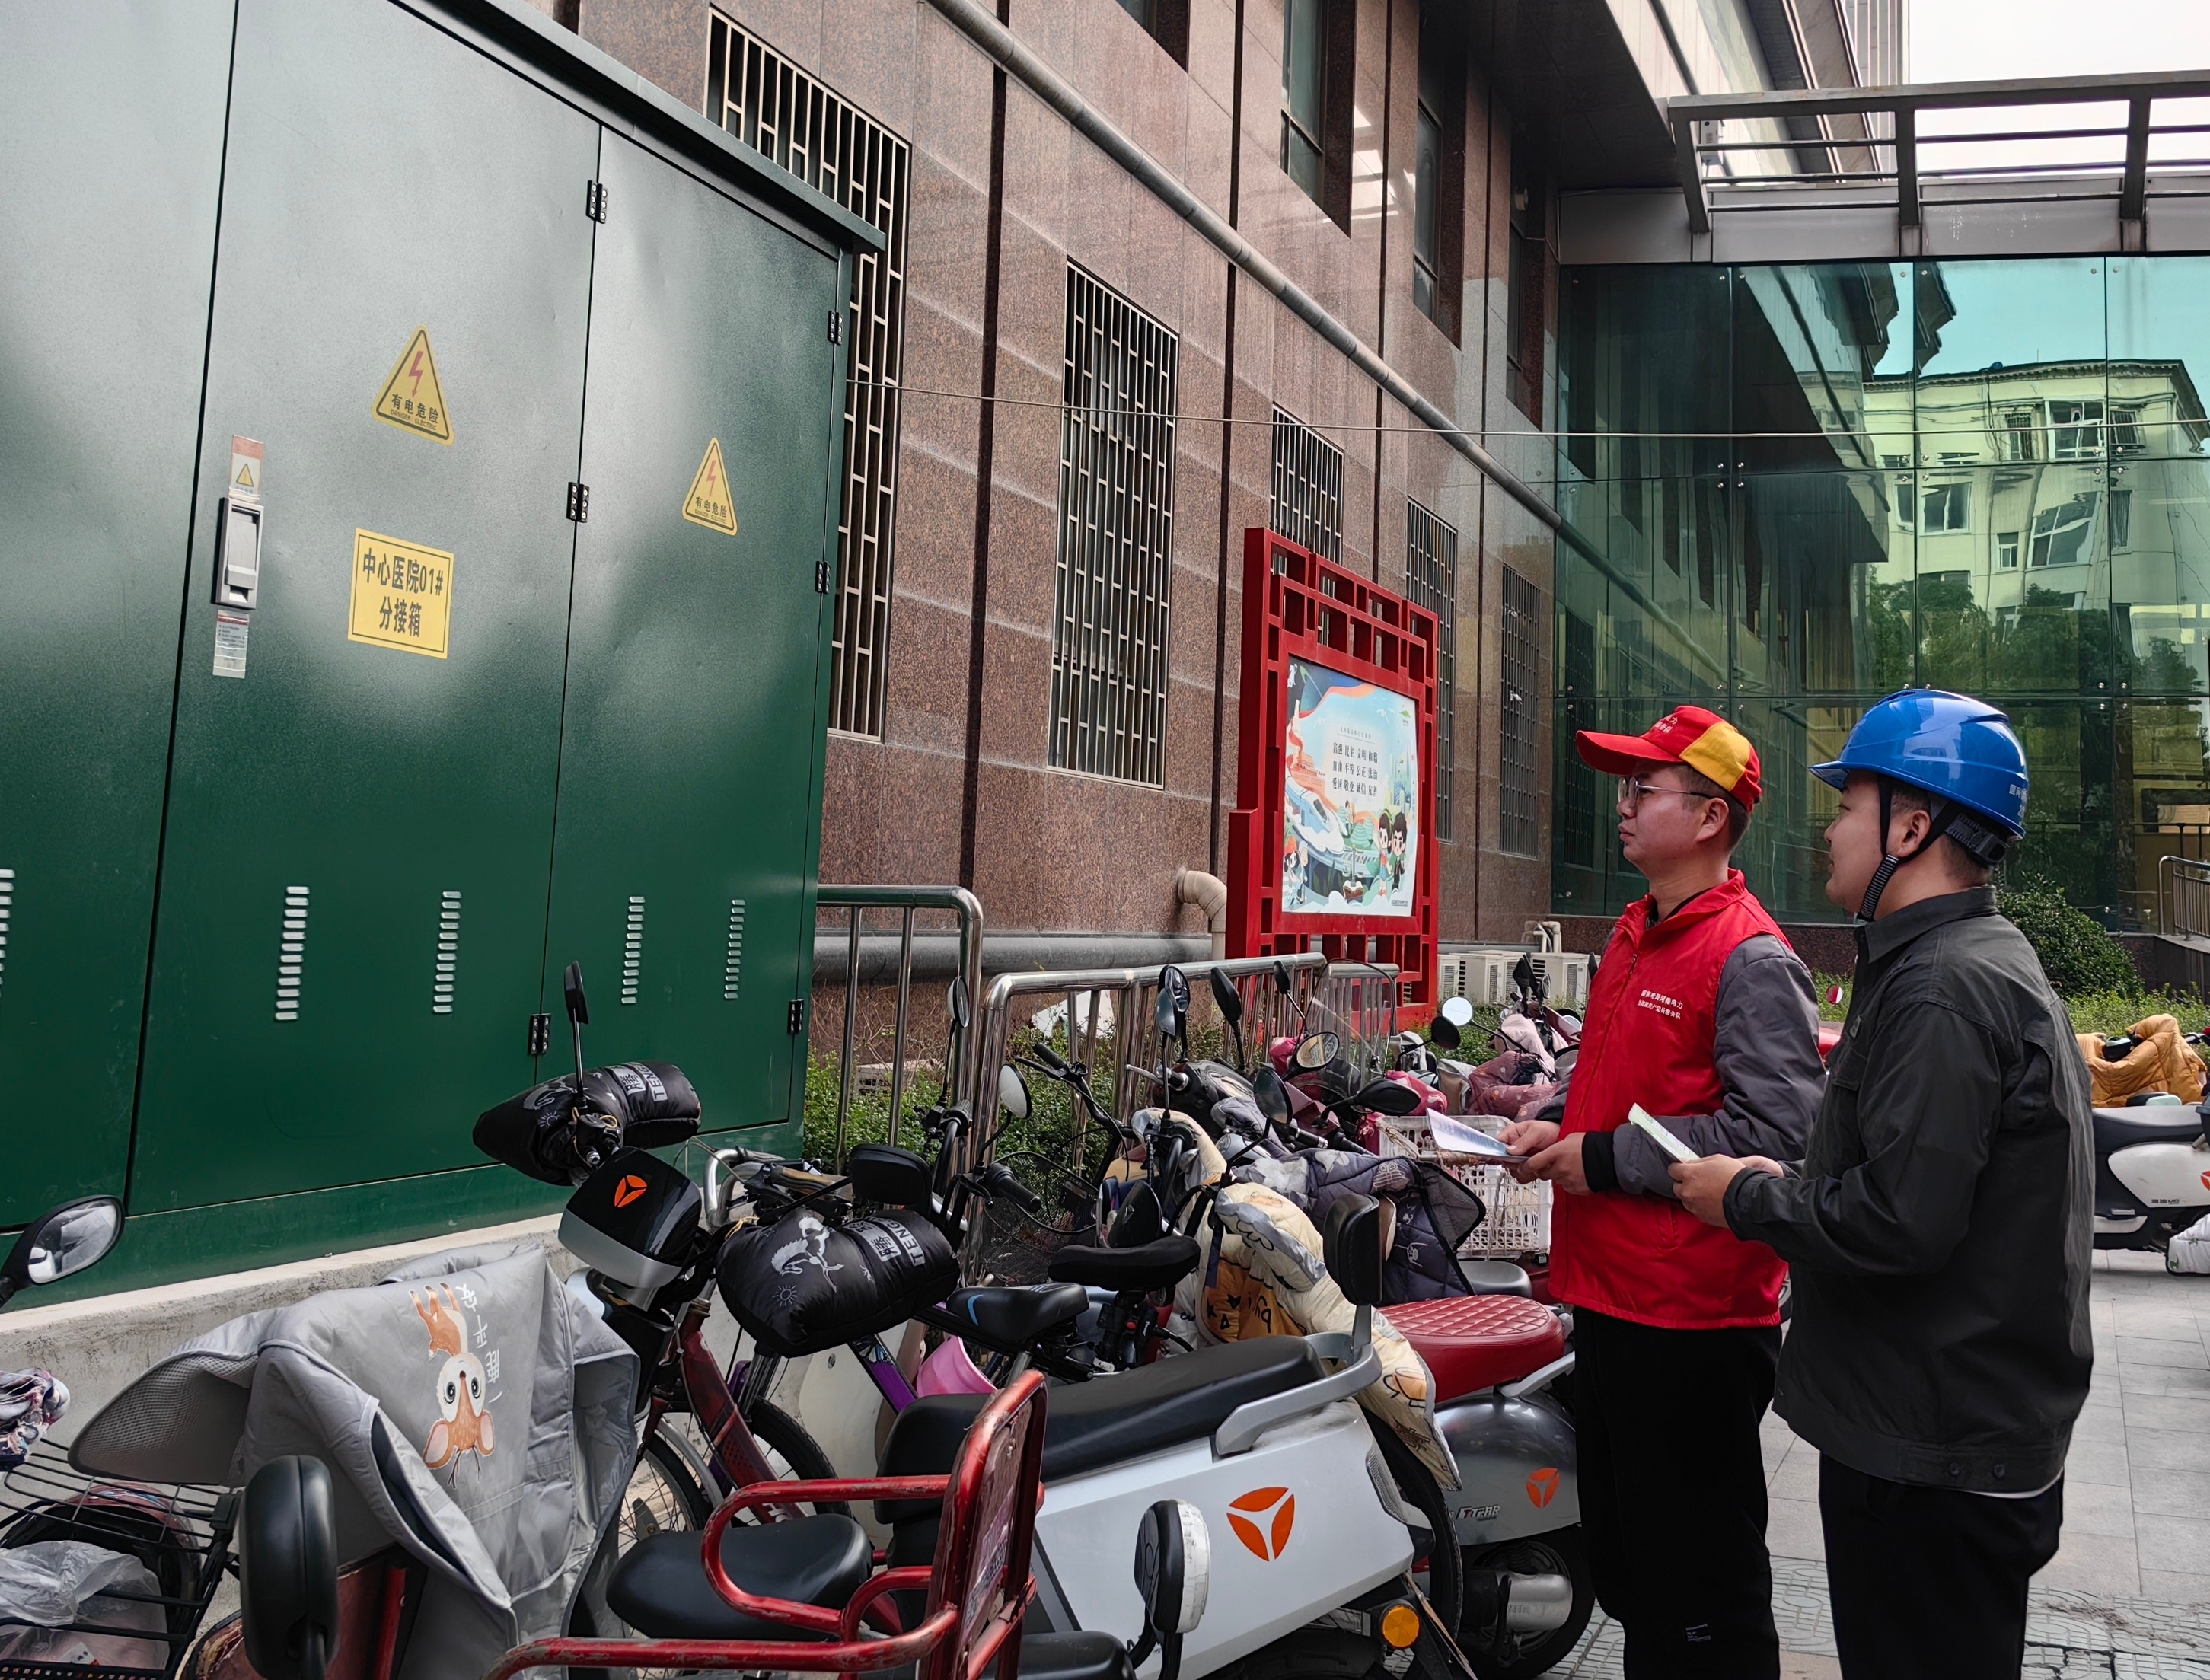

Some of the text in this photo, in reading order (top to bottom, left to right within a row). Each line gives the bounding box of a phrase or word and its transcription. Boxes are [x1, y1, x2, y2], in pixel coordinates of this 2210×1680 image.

[391, 394, 439, 424] 有电危险
[695, 496, 728, 518] 有电危险
[362, 547, 444, 597] 中心医院01#
[379, 595, 422, 630] 分接箱
